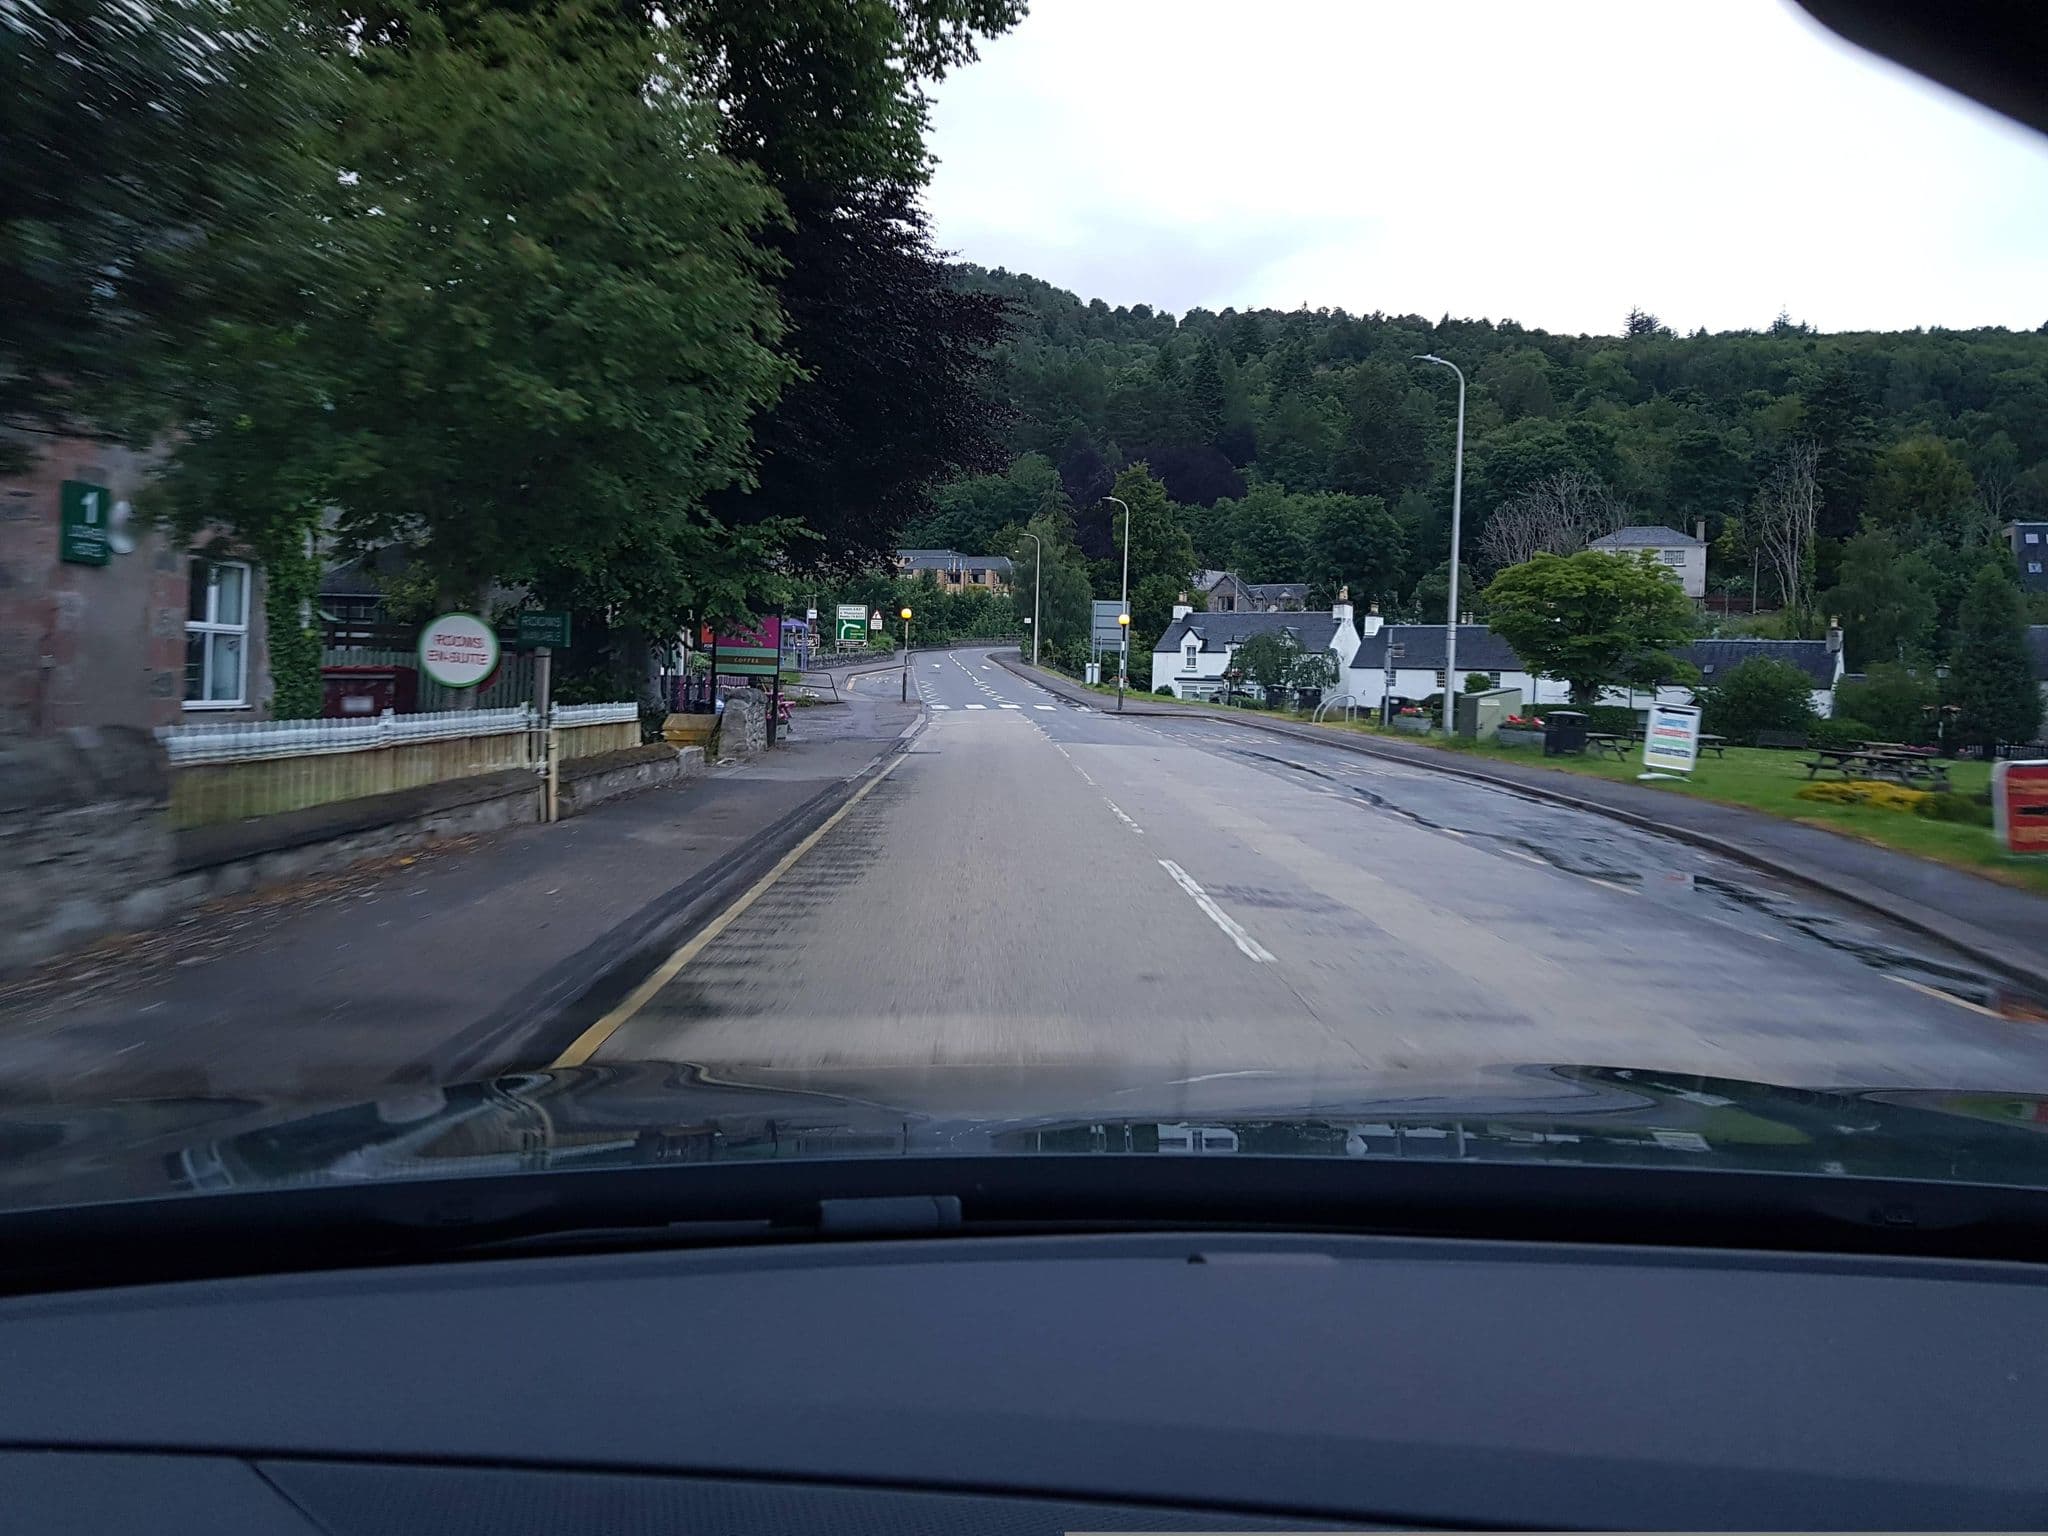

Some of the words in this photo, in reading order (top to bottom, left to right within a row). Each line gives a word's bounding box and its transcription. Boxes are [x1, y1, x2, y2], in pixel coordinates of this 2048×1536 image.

[81, 492, 99, 523] 1
[434, 634, 483, 648] ROOMS
[733, 656, 760, 664] COFFEE
